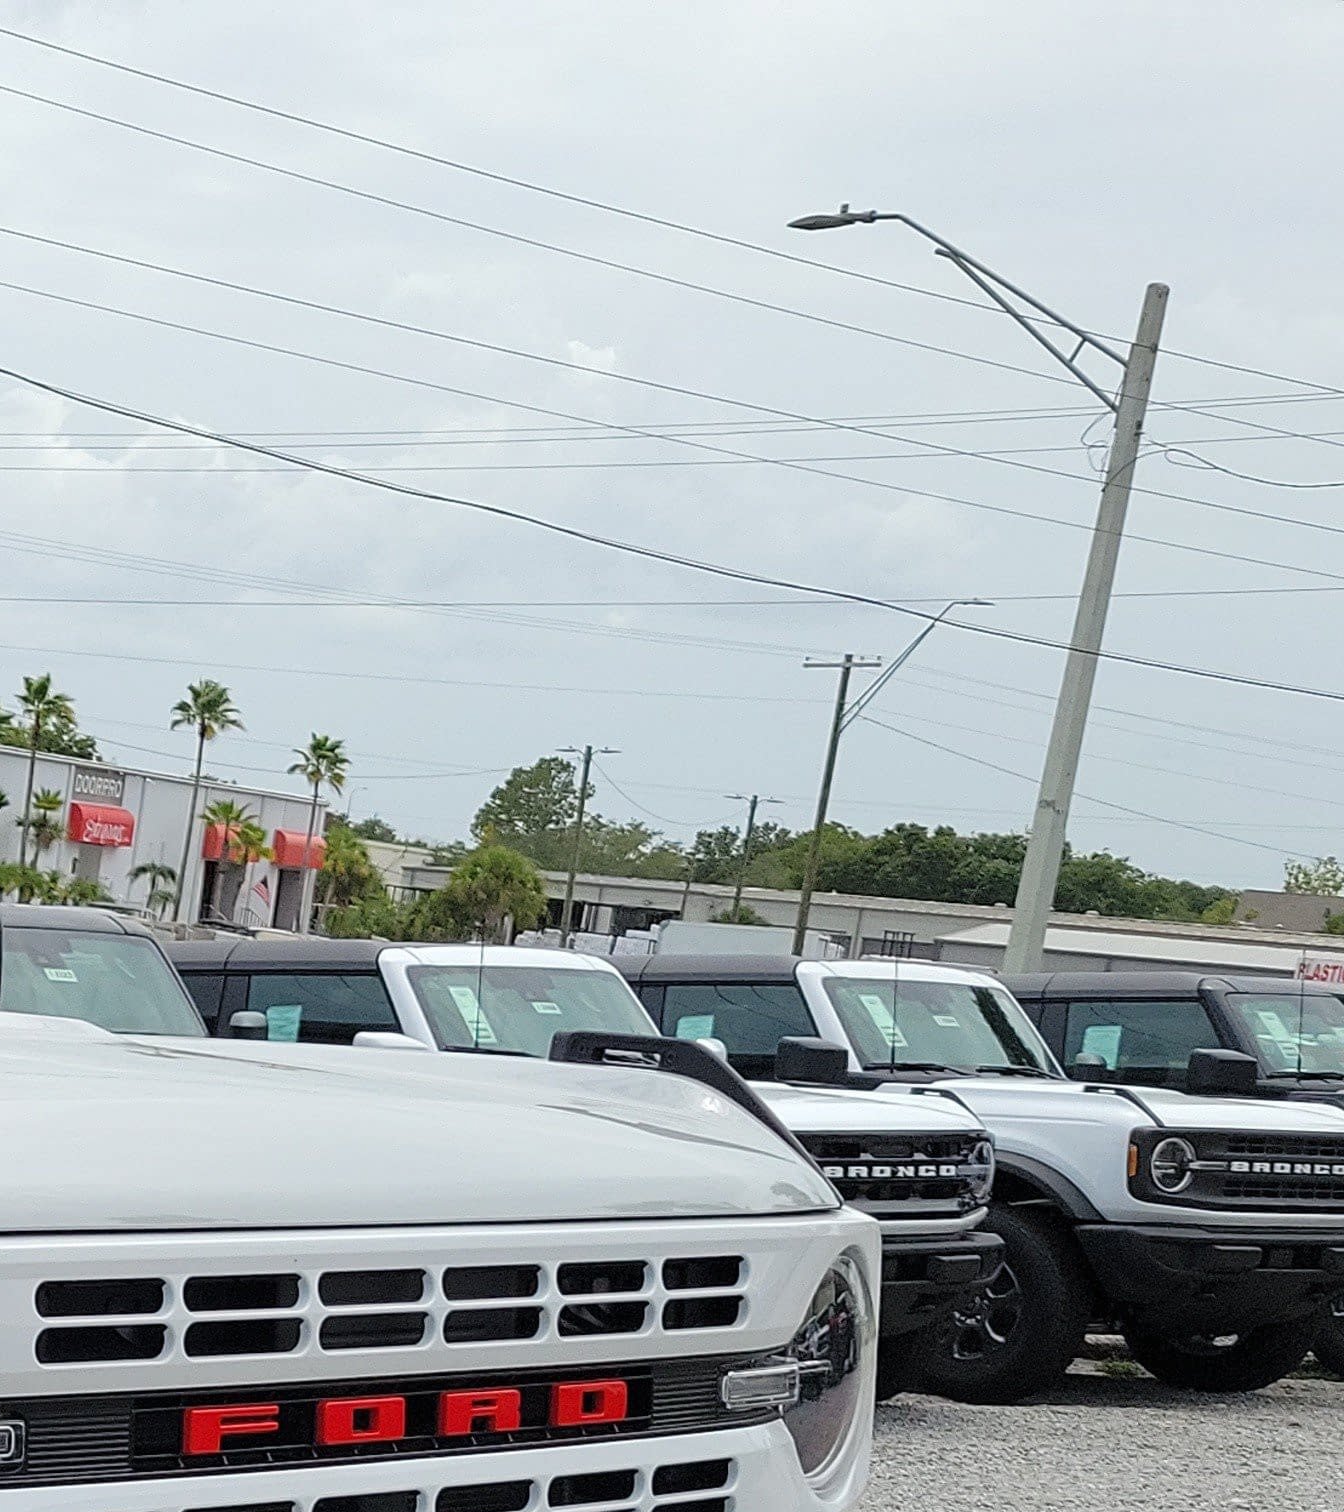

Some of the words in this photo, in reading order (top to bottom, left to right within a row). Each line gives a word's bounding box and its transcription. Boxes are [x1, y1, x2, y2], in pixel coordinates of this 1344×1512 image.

[1297, 962, 1344, 983] PLASTI
[822, 1164, 957, 1178] BRONCO
[1230, 1161, 1344, 1176] BRONCO
[182, 1380, 628, 1455] FORD
